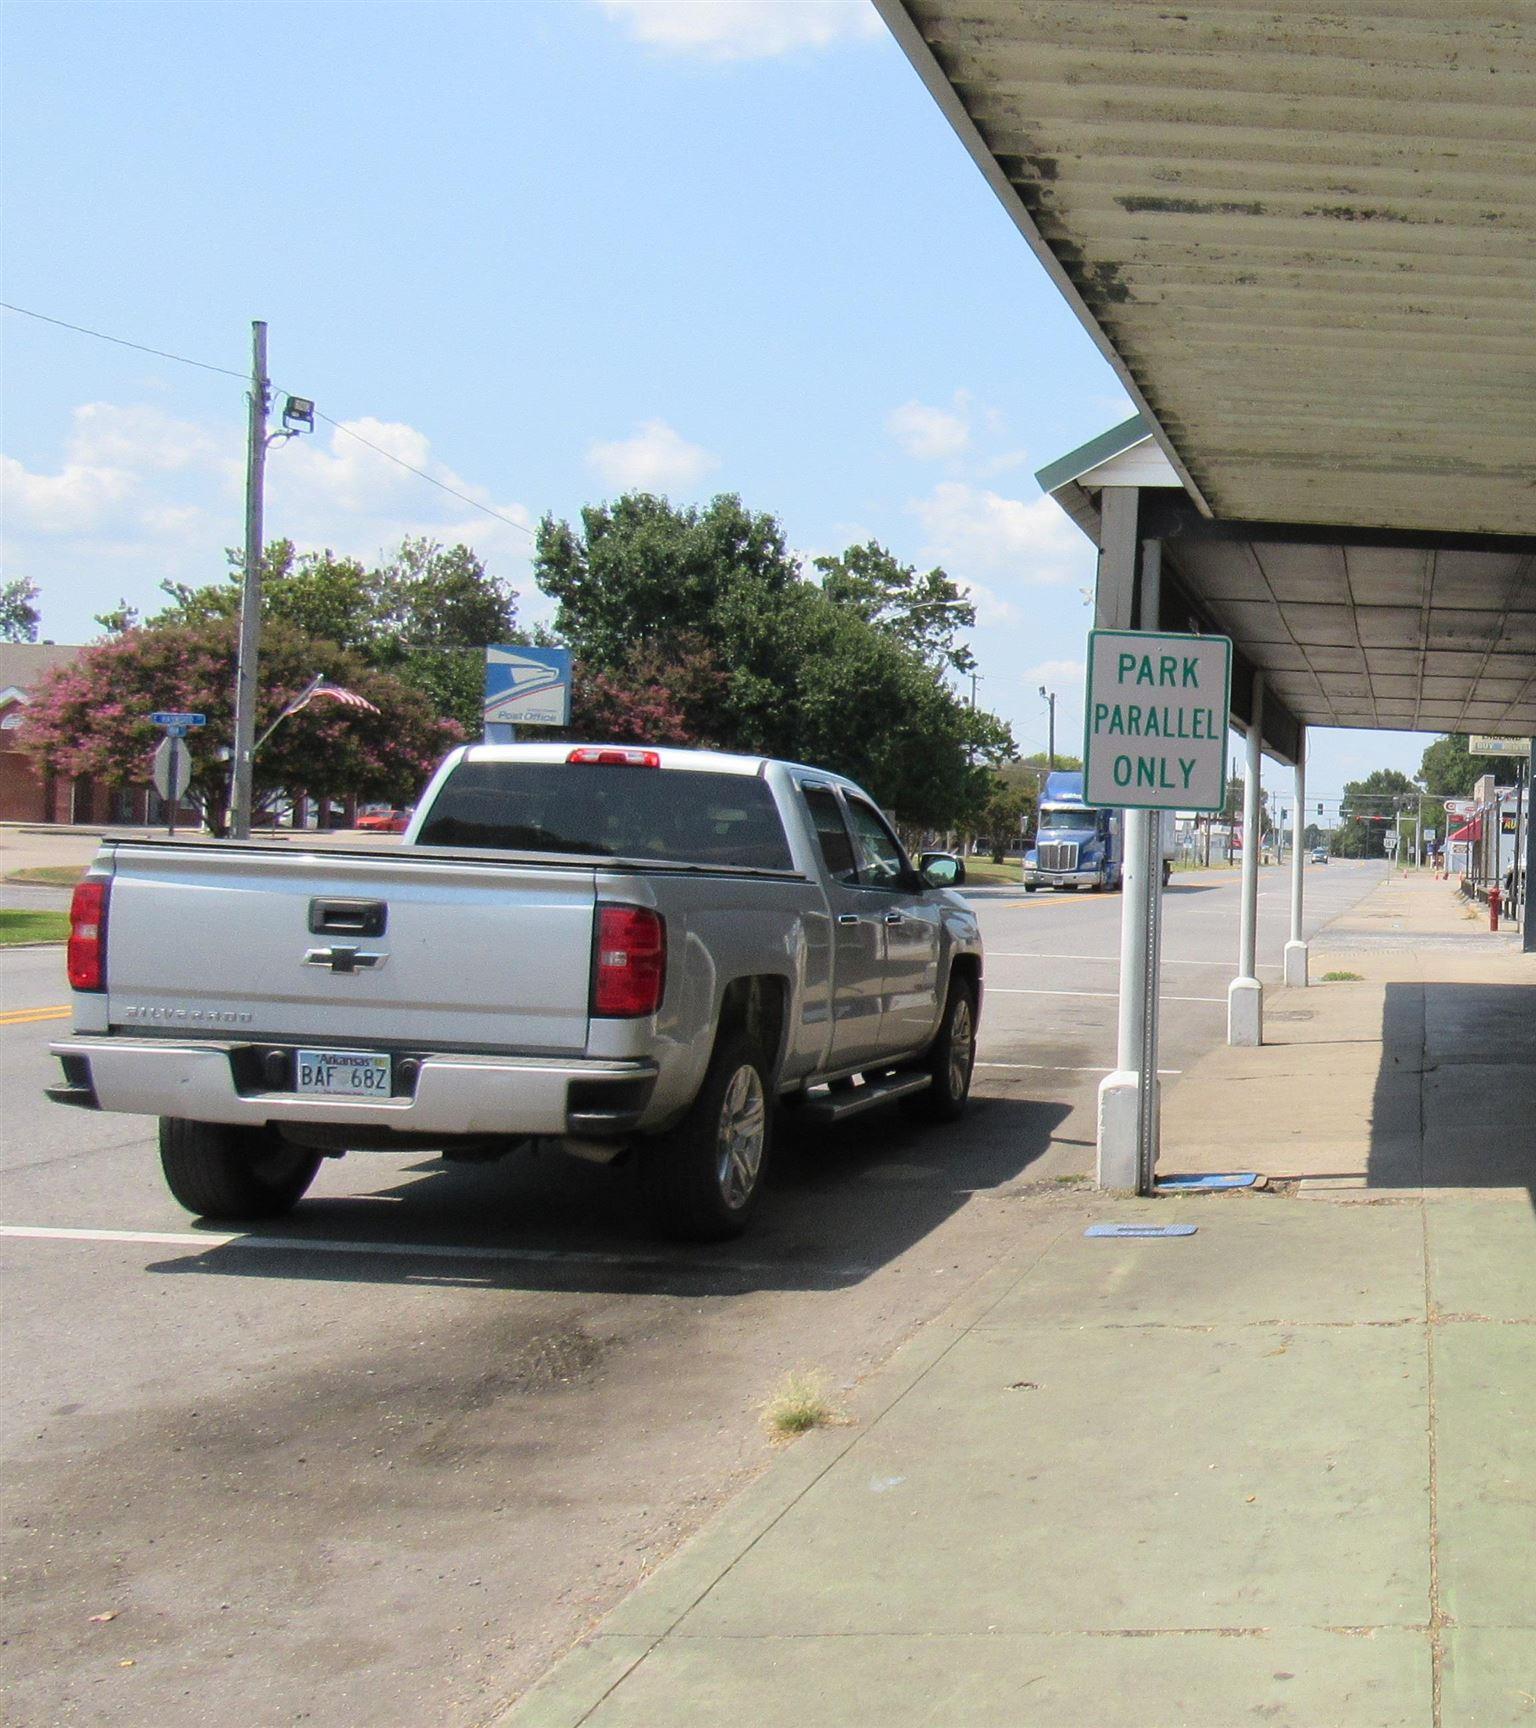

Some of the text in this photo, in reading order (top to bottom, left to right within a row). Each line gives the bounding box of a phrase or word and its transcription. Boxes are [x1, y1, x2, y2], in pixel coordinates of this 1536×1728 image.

[1117, 653, 1199, 688] PARK
[498, 711, 557, 722] Post Office
[1095, 703, 1219, 740] PARALLEL
[1113, 754, 1197, 789] ONLY
[320, 1053, 371, 1066] Arkansas
[301, 1065, 387, 1089] BAF 68Z
